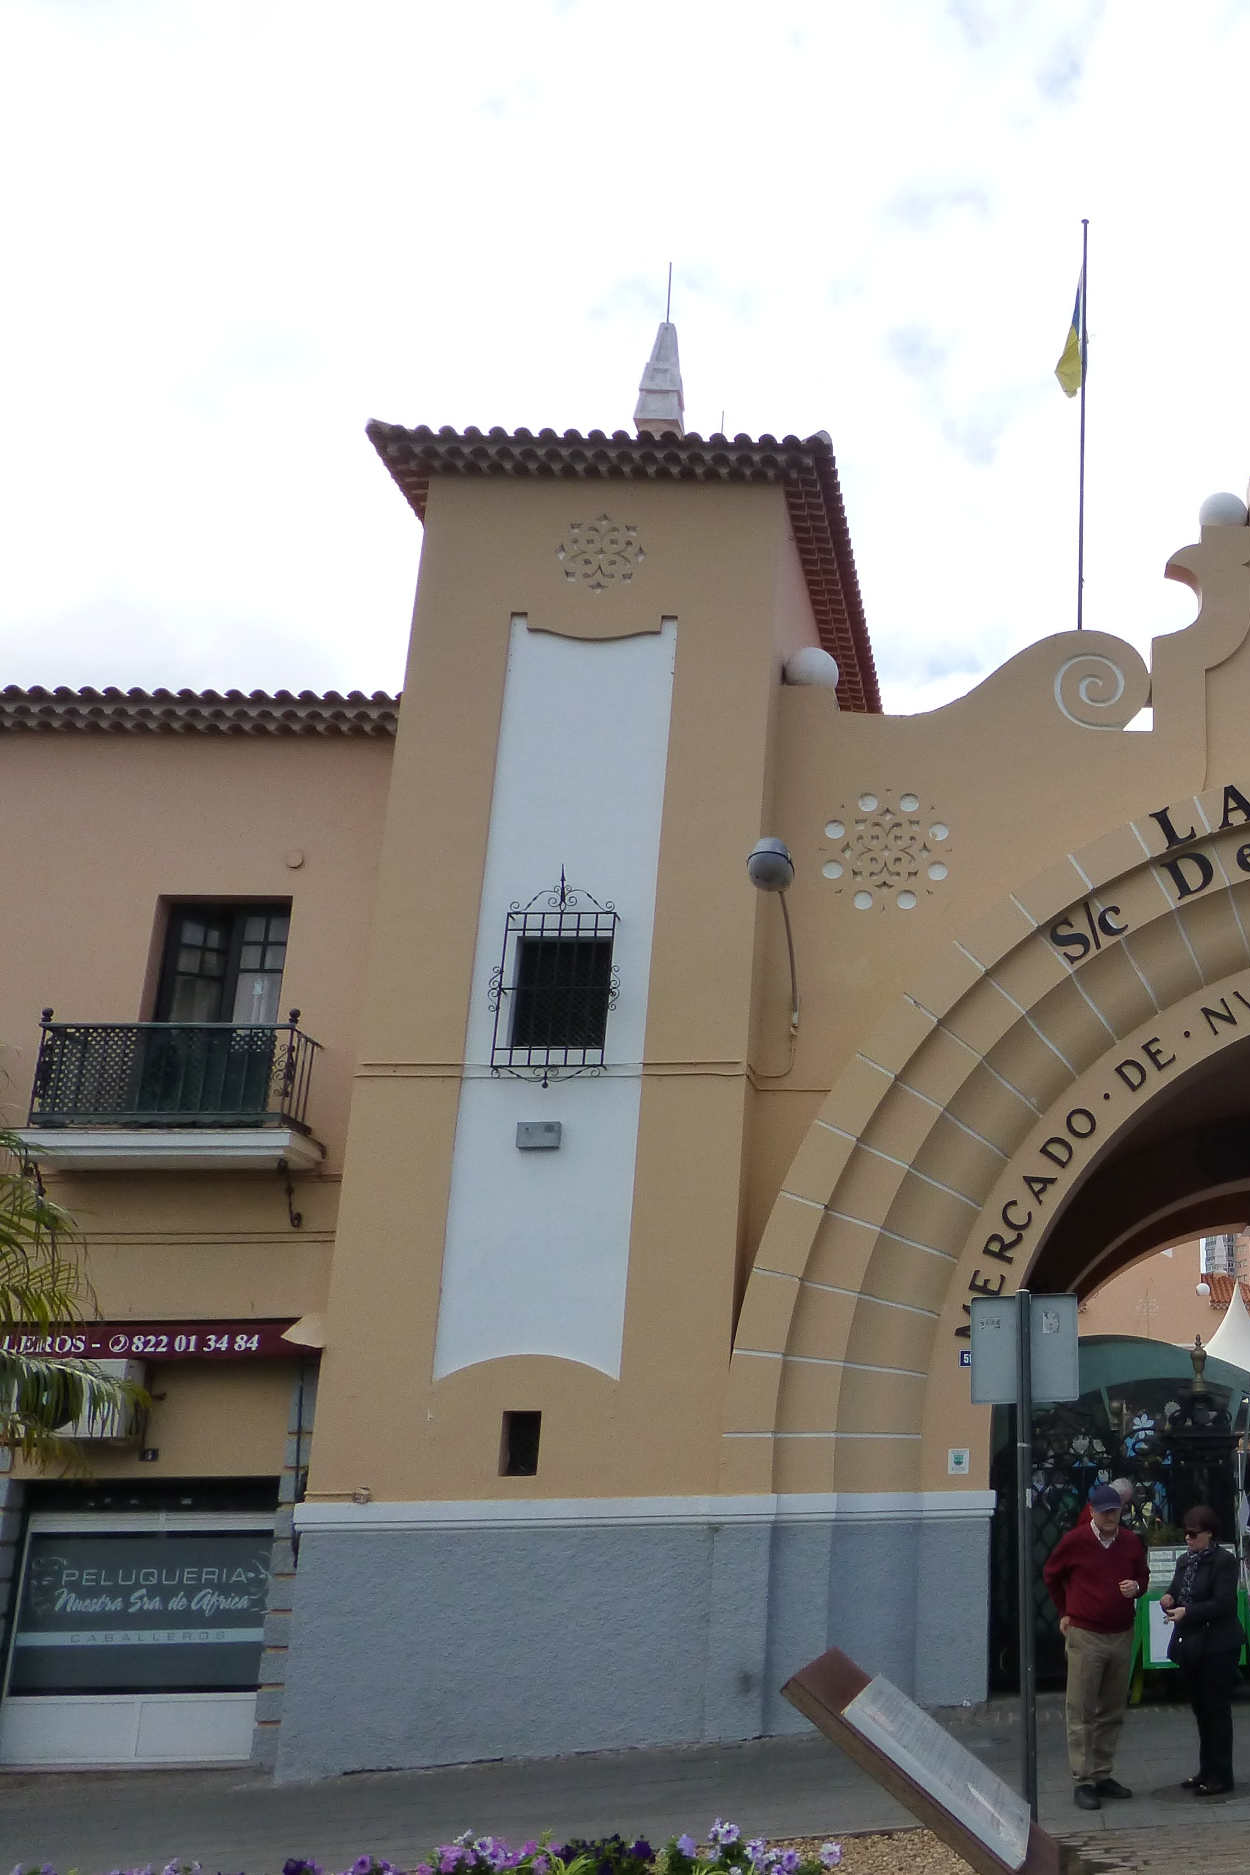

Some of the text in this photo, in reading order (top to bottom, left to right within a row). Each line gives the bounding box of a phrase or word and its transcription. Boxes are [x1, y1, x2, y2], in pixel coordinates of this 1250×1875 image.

[1115, 1037, 1176, 1092] DE
[131, 1334, 168, 1352] 822
[174, 1335, 197, 1352] 01
[203, 1334, 230, 1351] 34
[233, 1334, 260, 1351] 84
[61, 1568, 249, 1586] PELUQUERIA
[54, 1588, 124, 1613] Nuestra
[167, 1591, 188, 1611] de
[70, 1630, 226, 1644] CABALLEROS
